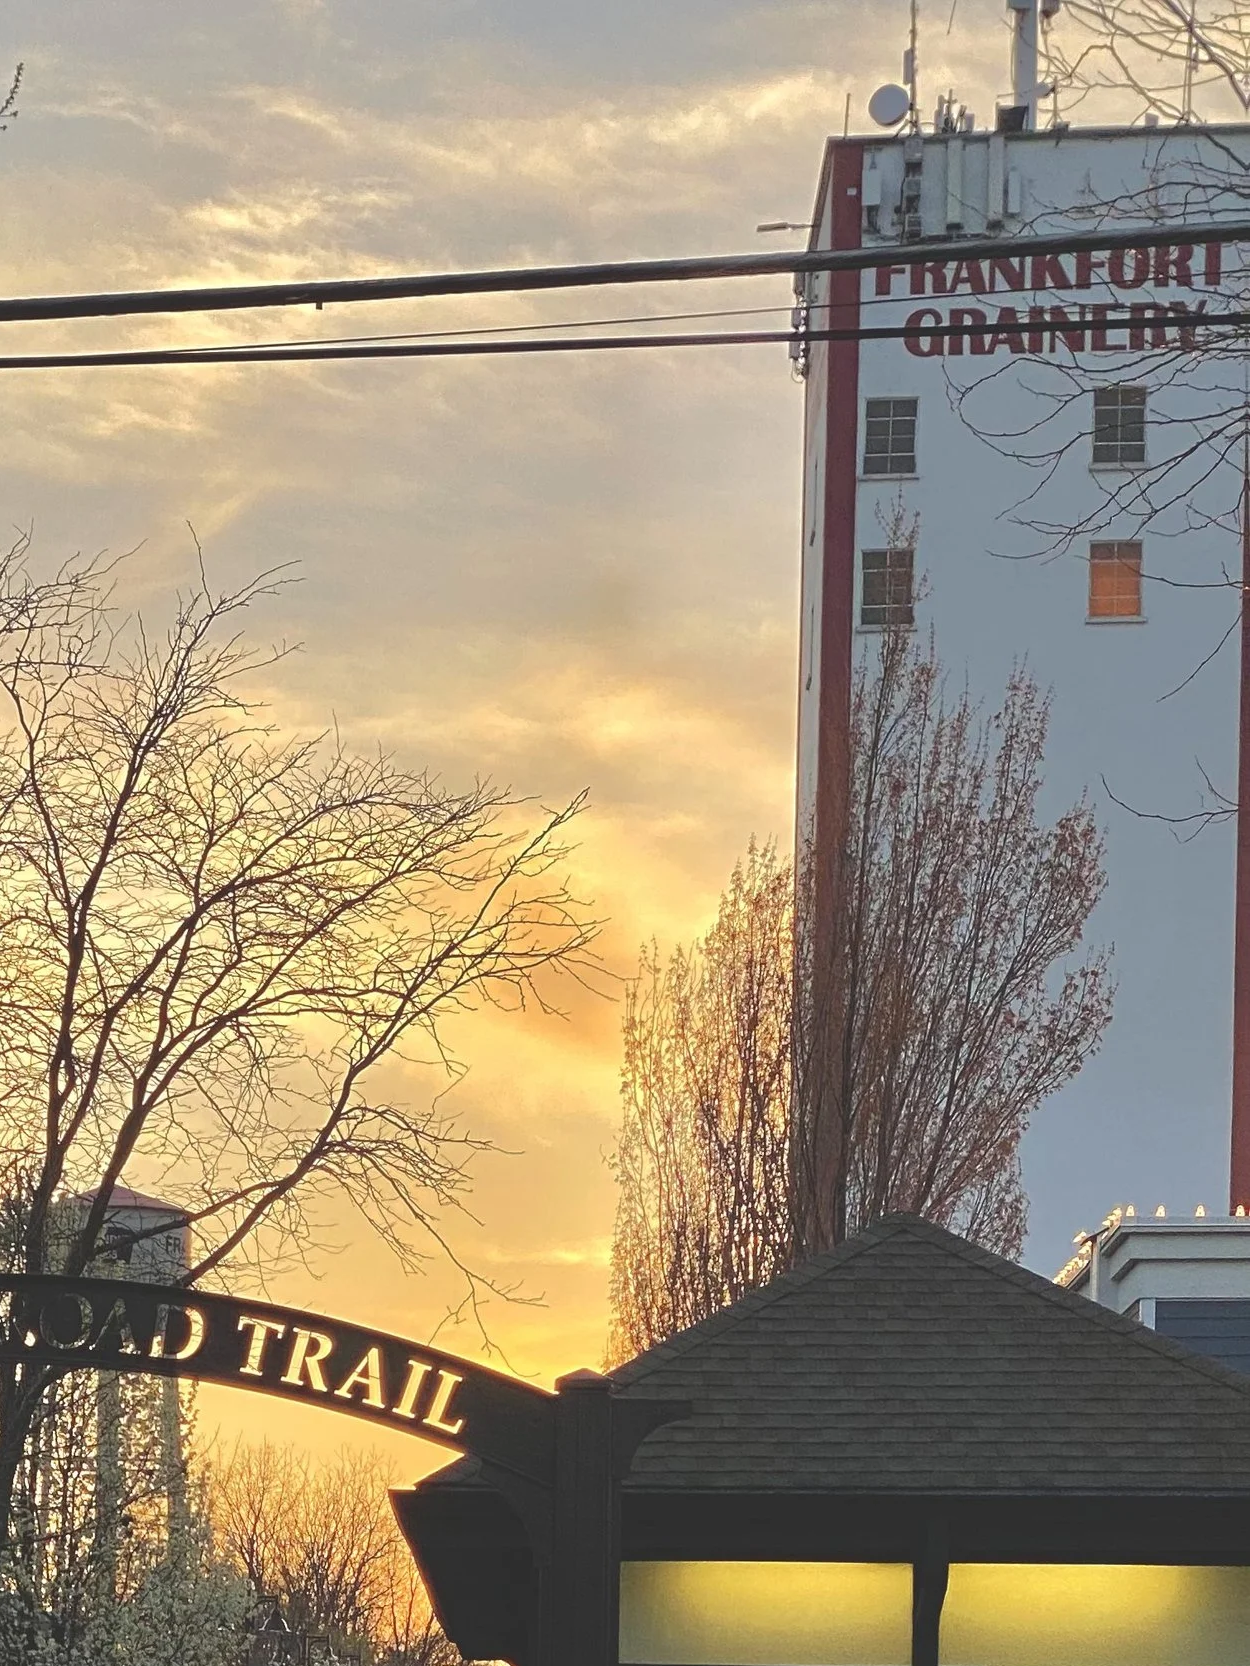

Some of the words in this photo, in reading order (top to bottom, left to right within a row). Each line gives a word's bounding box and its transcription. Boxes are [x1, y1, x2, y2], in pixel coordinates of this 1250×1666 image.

[874, 241, 1222, 296] FRANKFORT
[903, 300, 1207, 357] GRAINERY
[236, 1315, 468, 1434] TRAIL
